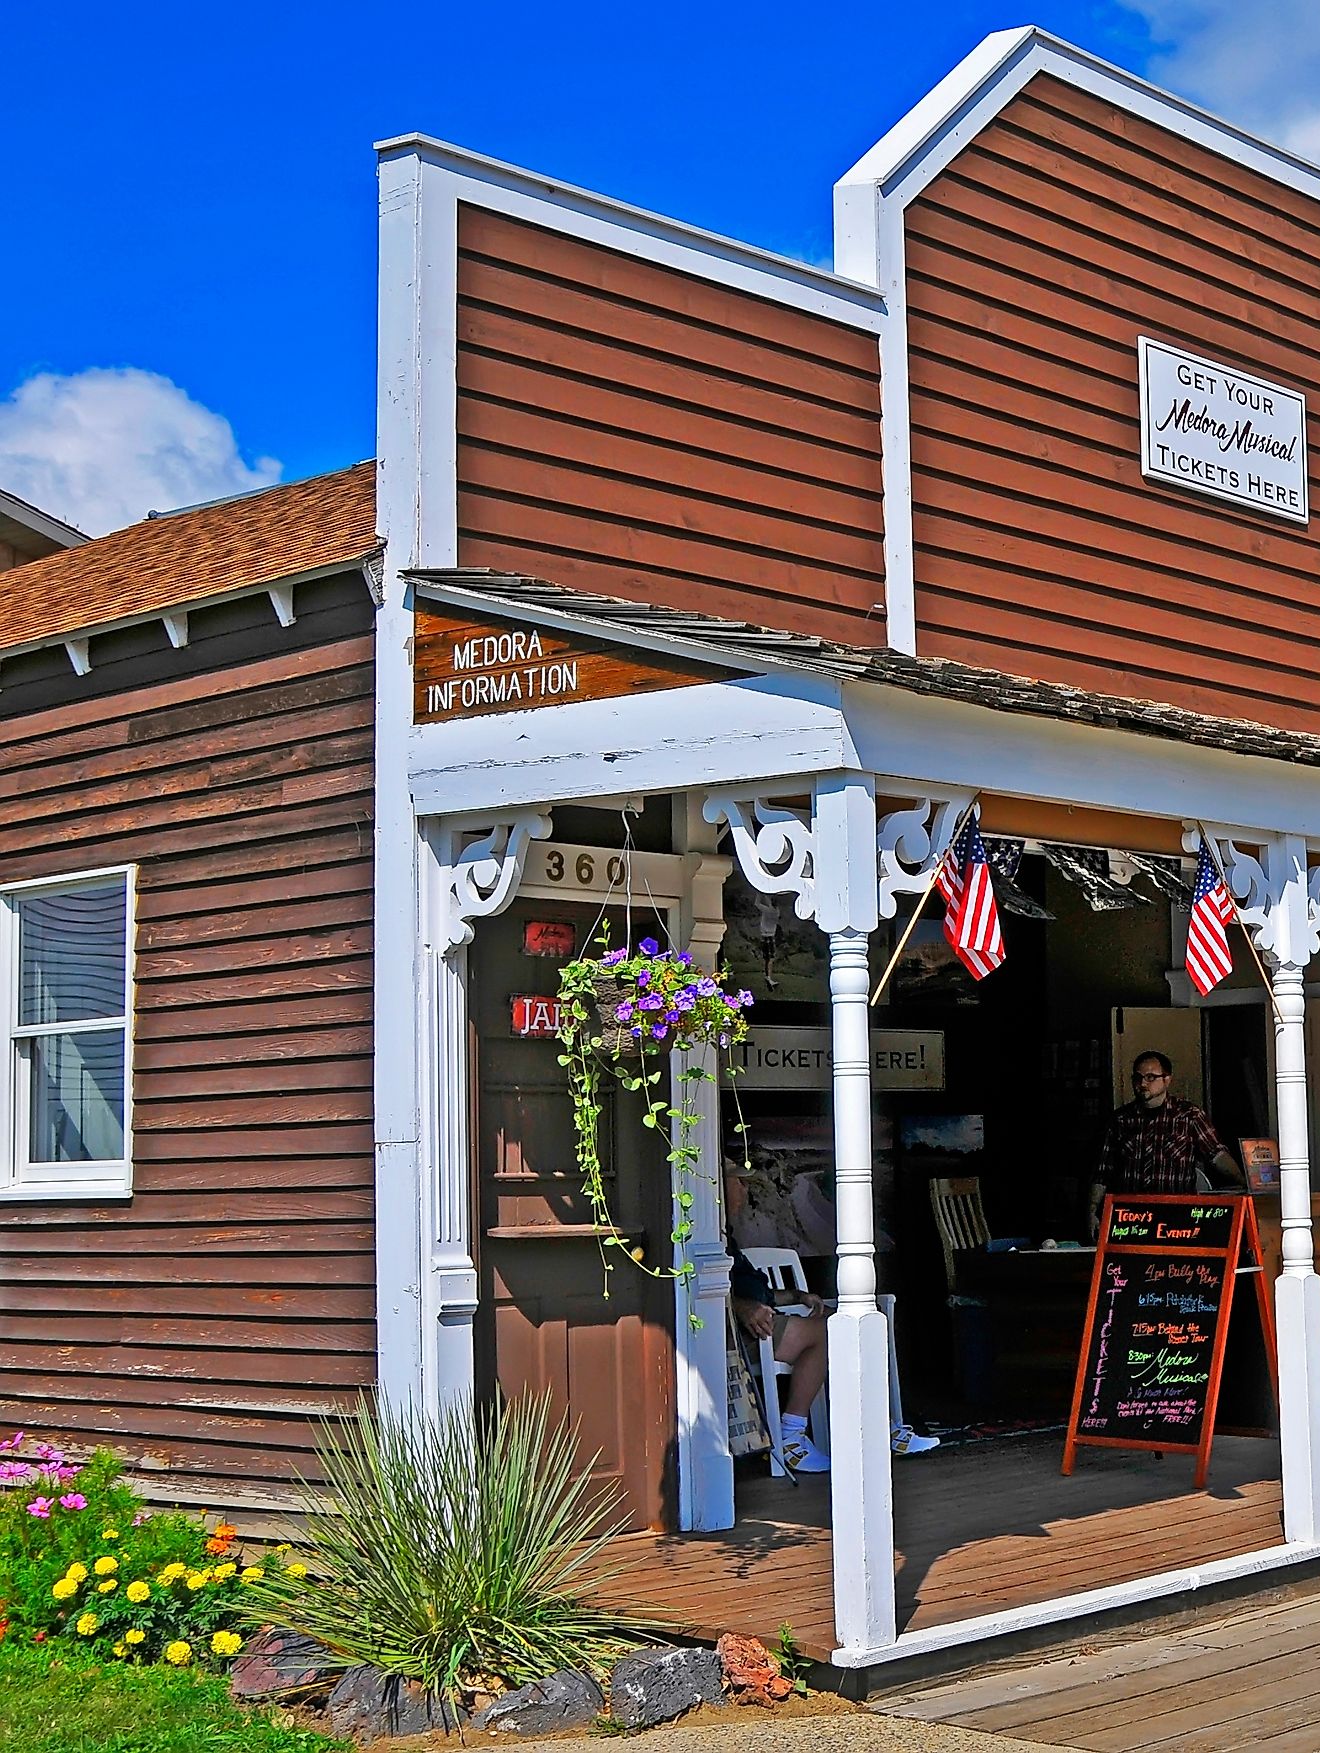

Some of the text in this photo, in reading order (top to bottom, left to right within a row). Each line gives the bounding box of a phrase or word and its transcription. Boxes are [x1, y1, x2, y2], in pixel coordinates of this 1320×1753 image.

[1176, 364, 1275, 417] GET YOUR
[1155, 398, 1298, 462] Medora Musical
[1156, 443, 1299, 508] TICKETS HERE
[453, 630, 543, 671] MEDORA
[428, 661, 577, 713] INFORMATION
[546, 850, 626, 886] 360
[875, 1045, 926, 1070] ERE!
